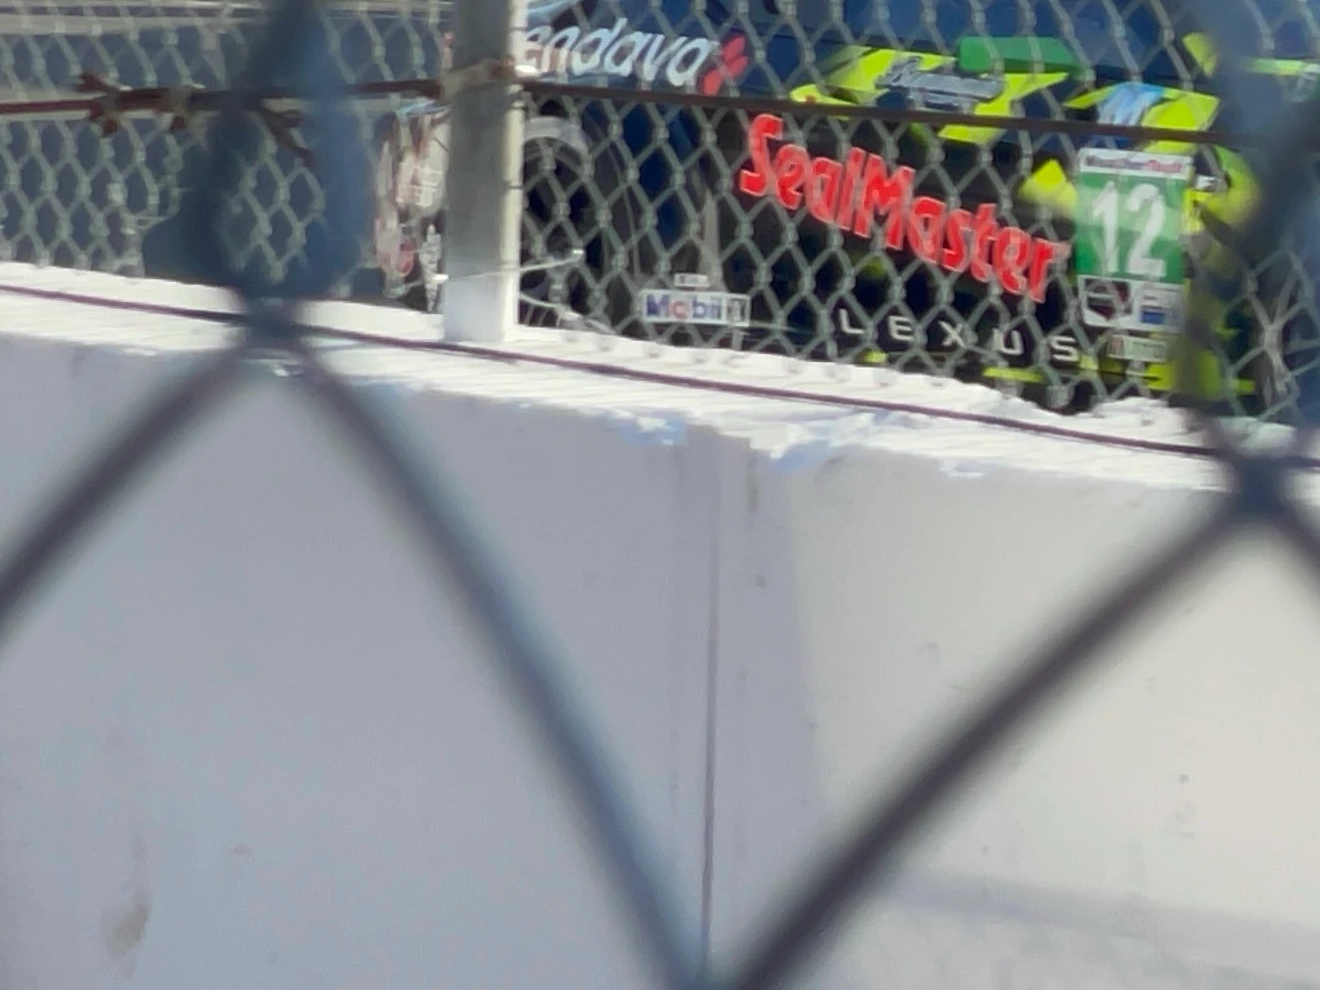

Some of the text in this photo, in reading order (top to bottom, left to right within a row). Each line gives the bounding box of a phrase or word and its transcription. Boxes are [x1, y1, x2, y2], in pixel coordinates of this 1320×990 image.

[524, 17, 719, 87] endava
[740, 113, 1071, 304] SealMaster
[1091, 180, 1168, 278] 12
[838, 308, 1079, 363] LEXUS
